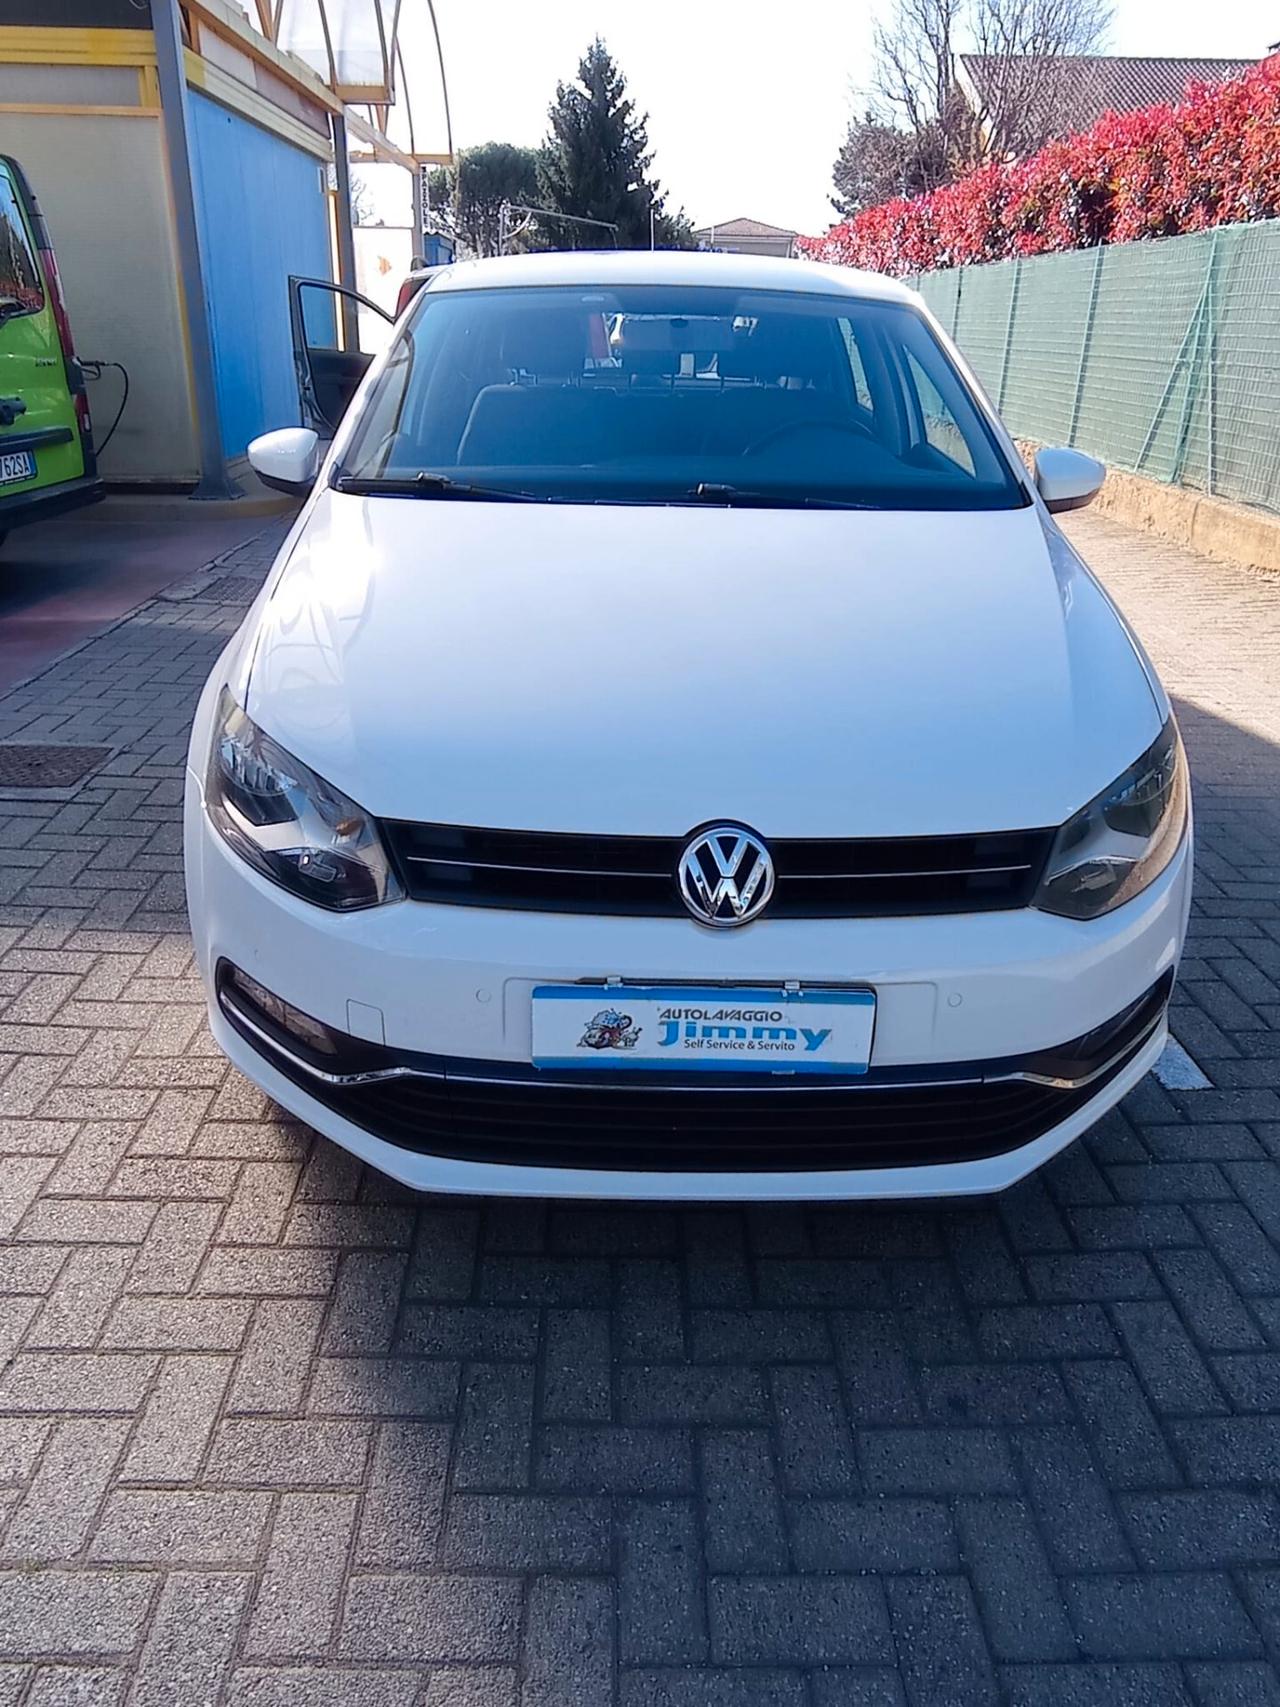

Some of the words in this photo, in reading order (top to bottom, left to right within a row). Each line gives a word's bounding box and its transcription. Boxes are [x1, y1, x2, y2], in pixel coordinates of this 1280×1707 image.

[659, 1007, 783, 1021] AUTOLAVAGGIO
[657, 1020, 832, 1051] Jimmy
[684, 1039, 705, 1049] Self
[706, 1040, 746, 1050] Service
[746, 1041, 755, 1050] &
[757, 1041, 795, 1051] Servito
